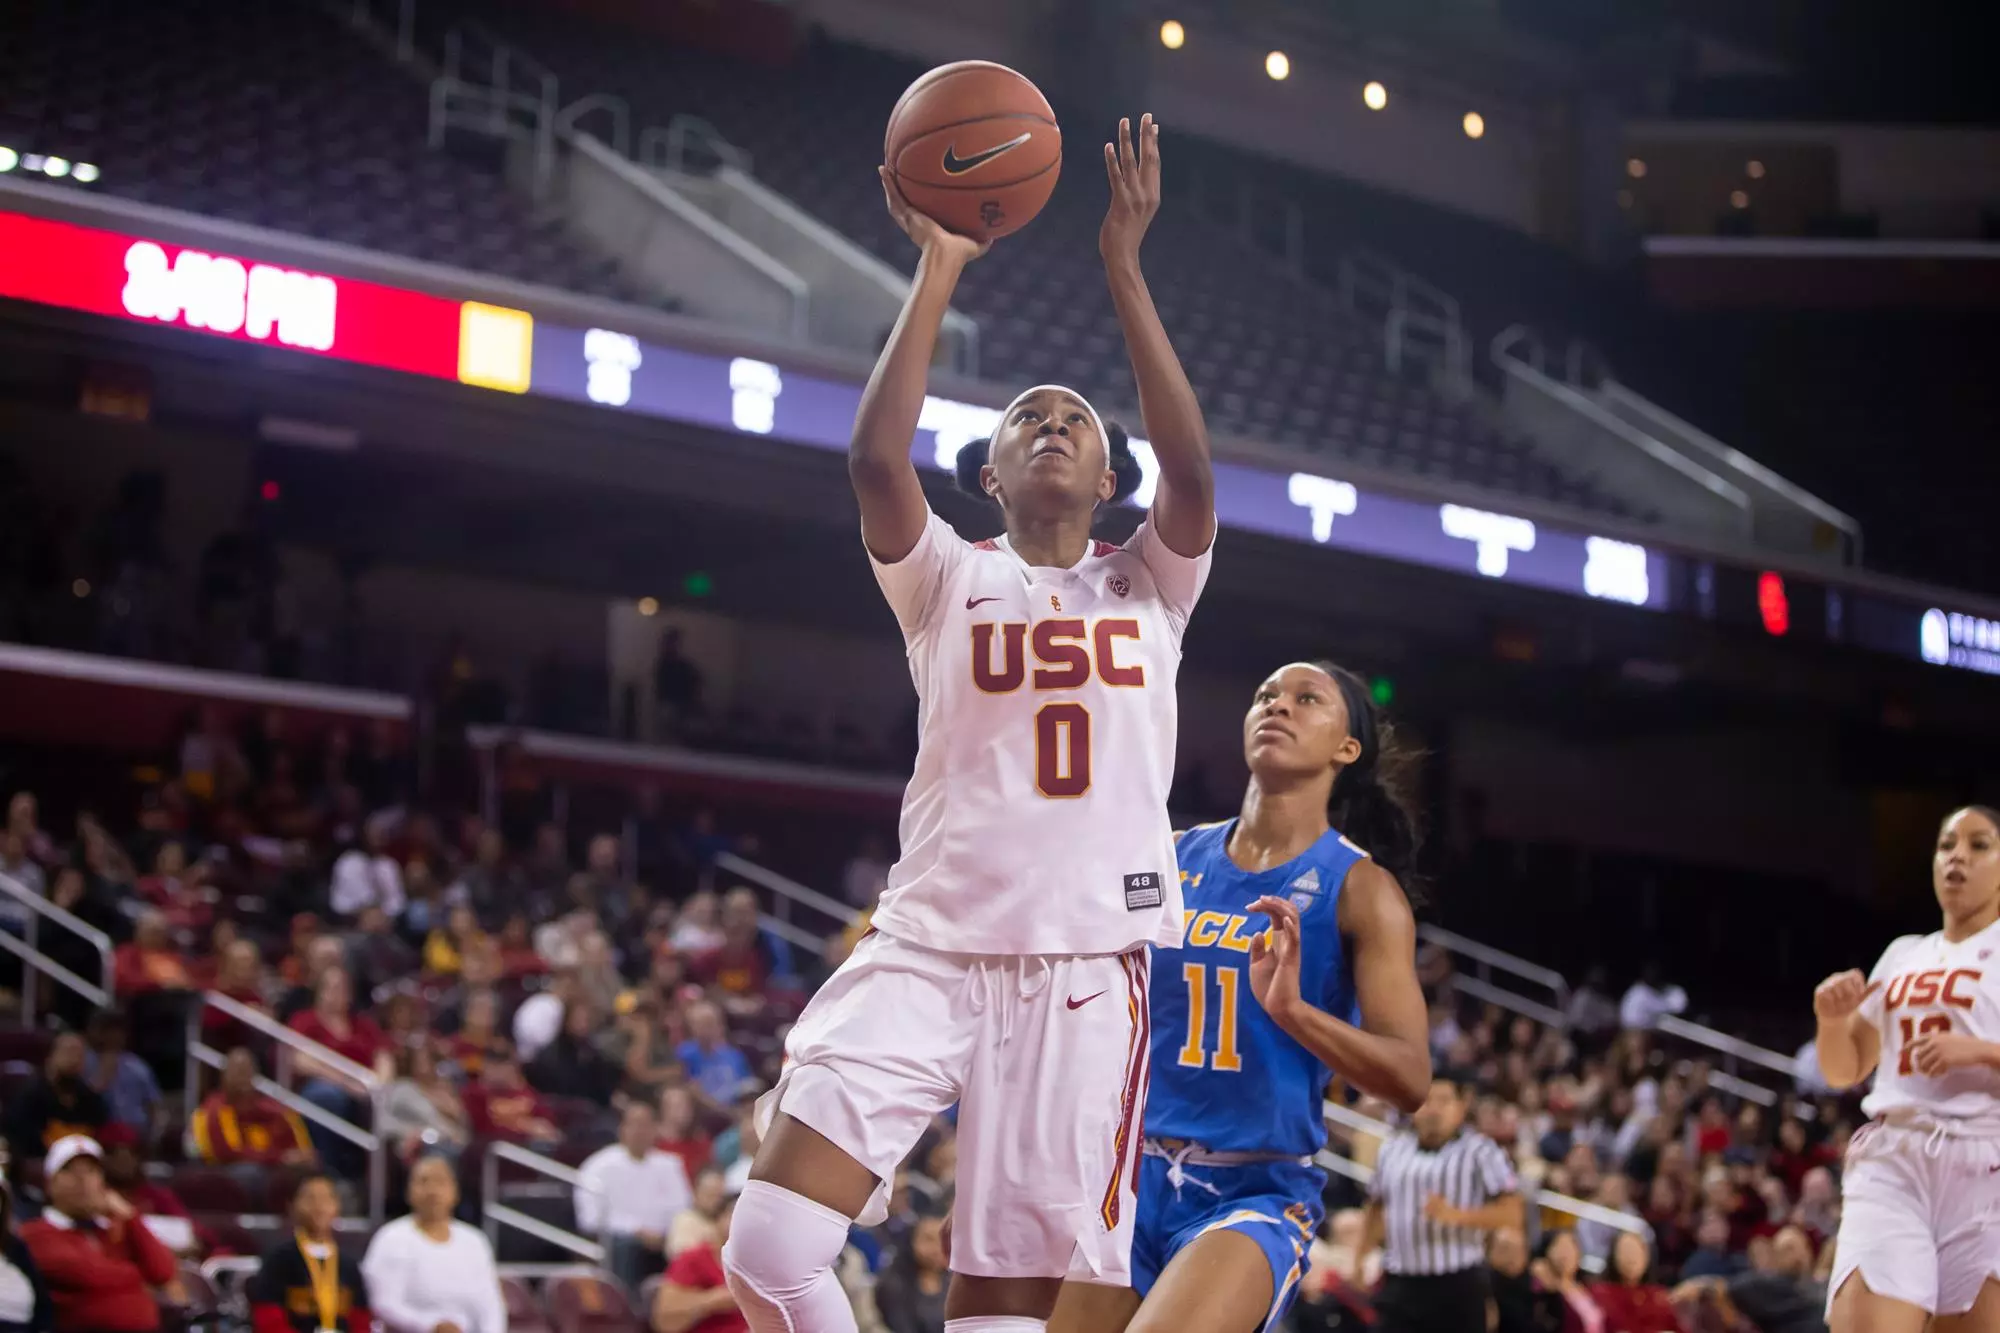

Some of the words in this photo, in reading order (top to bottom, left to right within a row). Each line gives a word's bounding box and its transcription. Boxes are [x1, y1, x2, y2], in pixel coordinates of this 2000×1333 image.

[970, 618, 1145, 694] USC
[1034, 701, 1092, 799] 0
[1131, 876, 1150, 887] 48
[1178, 962, 1241, 1072] 11
[1885, 968, 1982, 1012] USC
